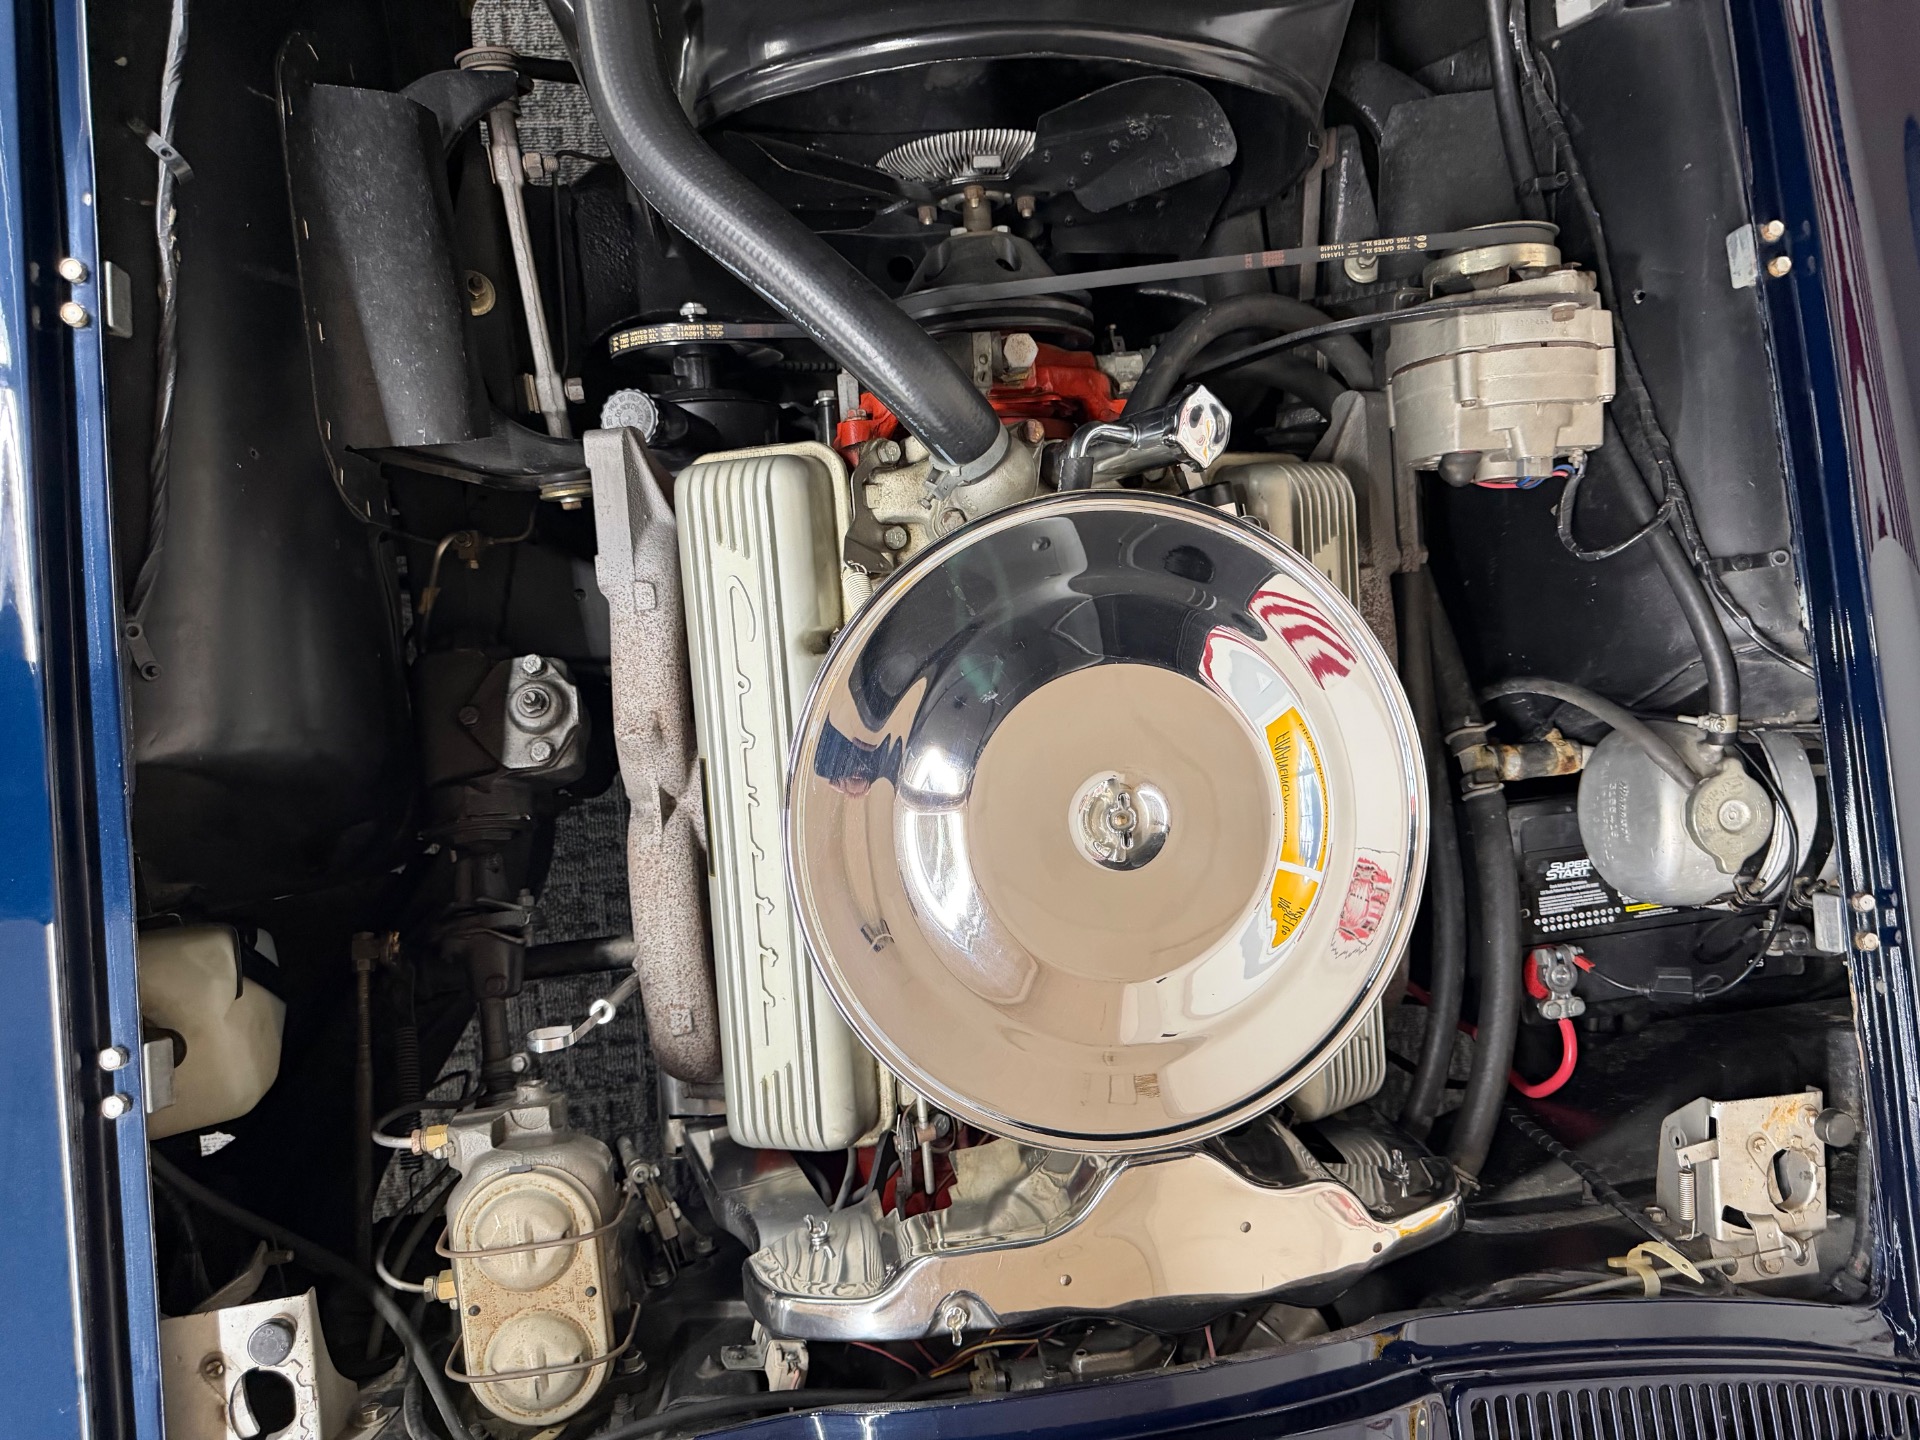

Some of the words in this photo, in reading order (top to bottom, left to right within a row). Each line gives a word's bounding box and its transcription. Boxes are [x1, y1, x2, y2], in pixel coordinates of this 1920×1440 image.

[1298, 722, 1326, 785] FINANCING
[1550, 859, 1590, 870] SUPER
[1546, 866, 1593, 881] START
